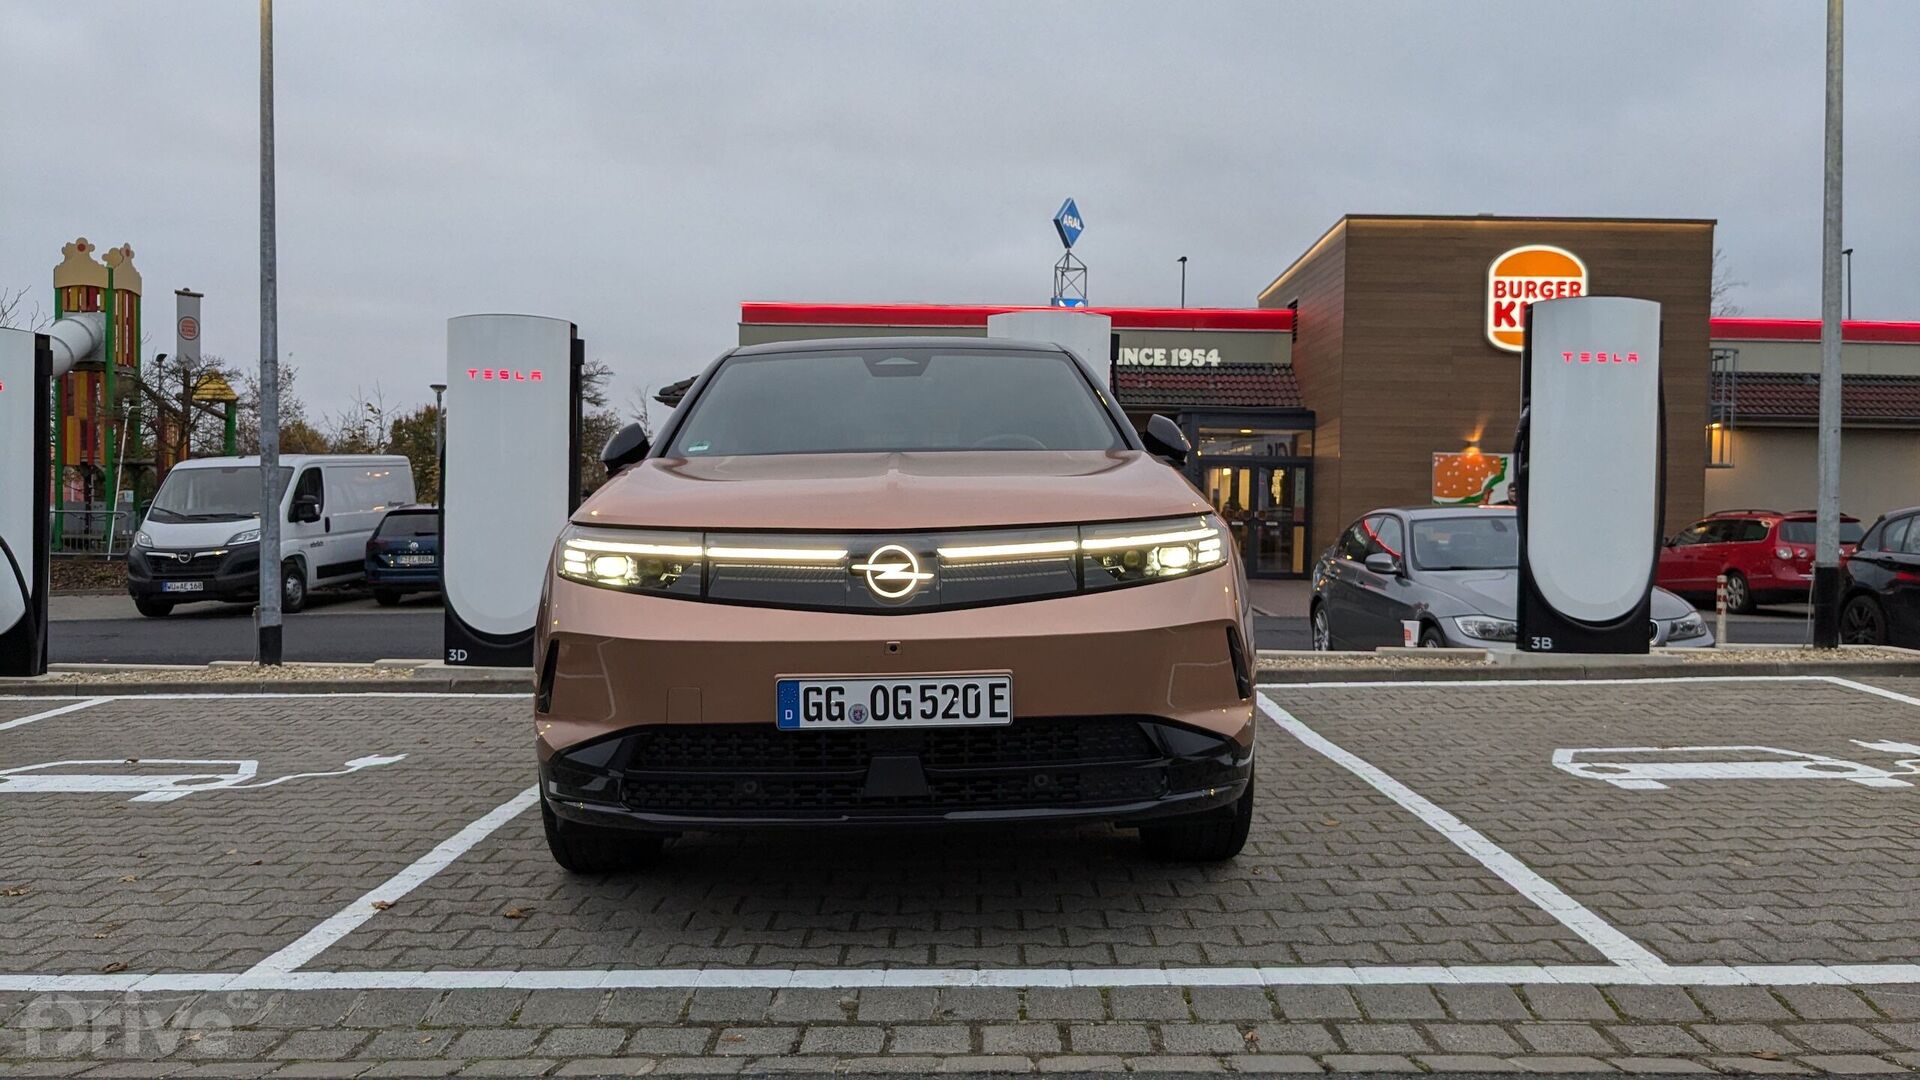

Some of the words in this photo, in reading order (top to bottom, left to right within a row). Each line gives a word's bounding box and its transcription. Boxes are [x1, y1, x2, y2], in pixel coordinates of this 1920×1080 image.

[1063, 214, 1081, 231] ARAL
[1494, 281, 1582, 299] BURGER
[1494, 301, 1528, 328] KI
[1117, 347, 1167, 366] INCE
[1171, 348, 1221, 367] 1954
[1562, 351, 1639, 364] TESLA
[467, 368, 543, 381] TESLA
[1531, 636, 1553, 649] 3B
[448, 648, 468, 661] 3D
[803, 686, 845, 722] GG
[785, 709, 793, 720] D
